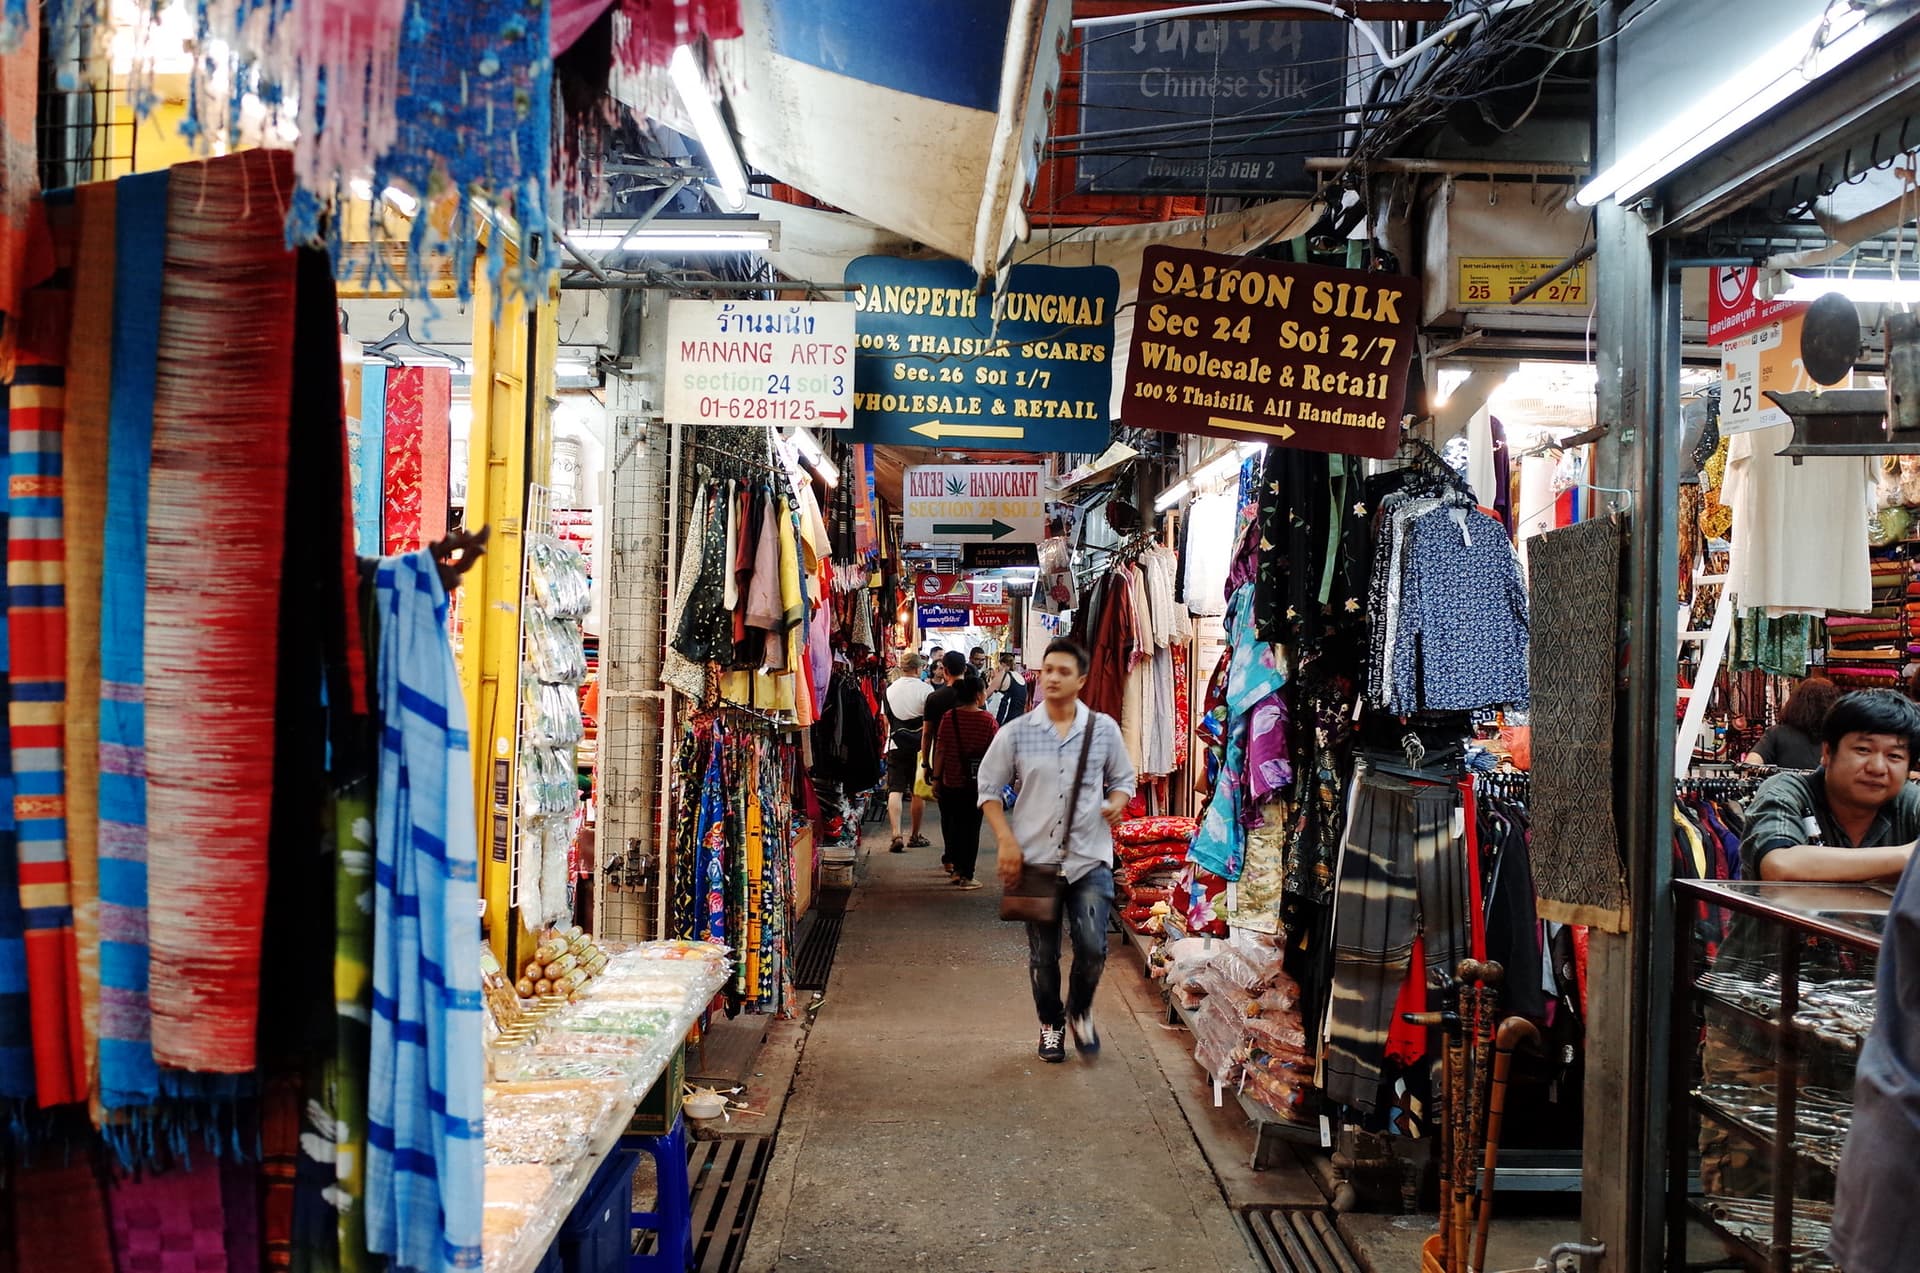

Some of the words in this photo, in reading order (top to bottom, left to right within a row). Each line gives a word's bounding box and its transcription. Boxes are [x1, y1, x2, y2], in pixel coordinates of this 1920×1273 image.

[1140, 67, 1249, 98] Chinese
[1257, 68, 1308, 99] Silk
[1265, 160, 1275, 178] 2
[1152, 260, 1295, 310] SAIFON
[1312, 280, 1402, 324] SILK
[1469, 285, 1491, 299] 25
[1549, 285, 1581, 302] 2/7
[1147, 304, 1200, 337] Sec
[1212, 315, 1251, 344] 24
[1279, 320, 1330, 354] Soi
[1340, 333, 1397, 367] 2/7
[681, 341, 773, 364] MANANG
[791, 343, 848, 365] ARTS
[1021, 341, 1105, 362] SCARFS
[1016, 368, 1051, 389] 1/7
[1141, 341, 1272, 384] Wholesale
[1279, 368, 1295, 388] &
[1302, 363, 1389, 400] Retail
[684, 372, 764, 392] section
[767, 374, 791, 394] 24
[797, 374, 828, 393] soi
[832, 375, 844, 396] 3
[700, 397, 816, 421] 01-6281125
[991, 398, 1006, 415] &
[1014, 399, 1098, 420] RETAIL
[1183, 385, 1254, 413] Thaisilk
[1263, 398, 1291, 418] All
[1297, 402, 1387, 430] Handmade
[1732, 385, 1752, 414] 25
[970, 472, 1038, 497] HANDICRAFT
[909, 502, 974, 517] SECTION
[979, 502, 997, 517] 25
[1002, 502, 1027, 517] SOI
[1031, 502, 1041, 517] 2
[981, 582, 998, 592] 26
[978, 617, 1002, 625] VIPA
